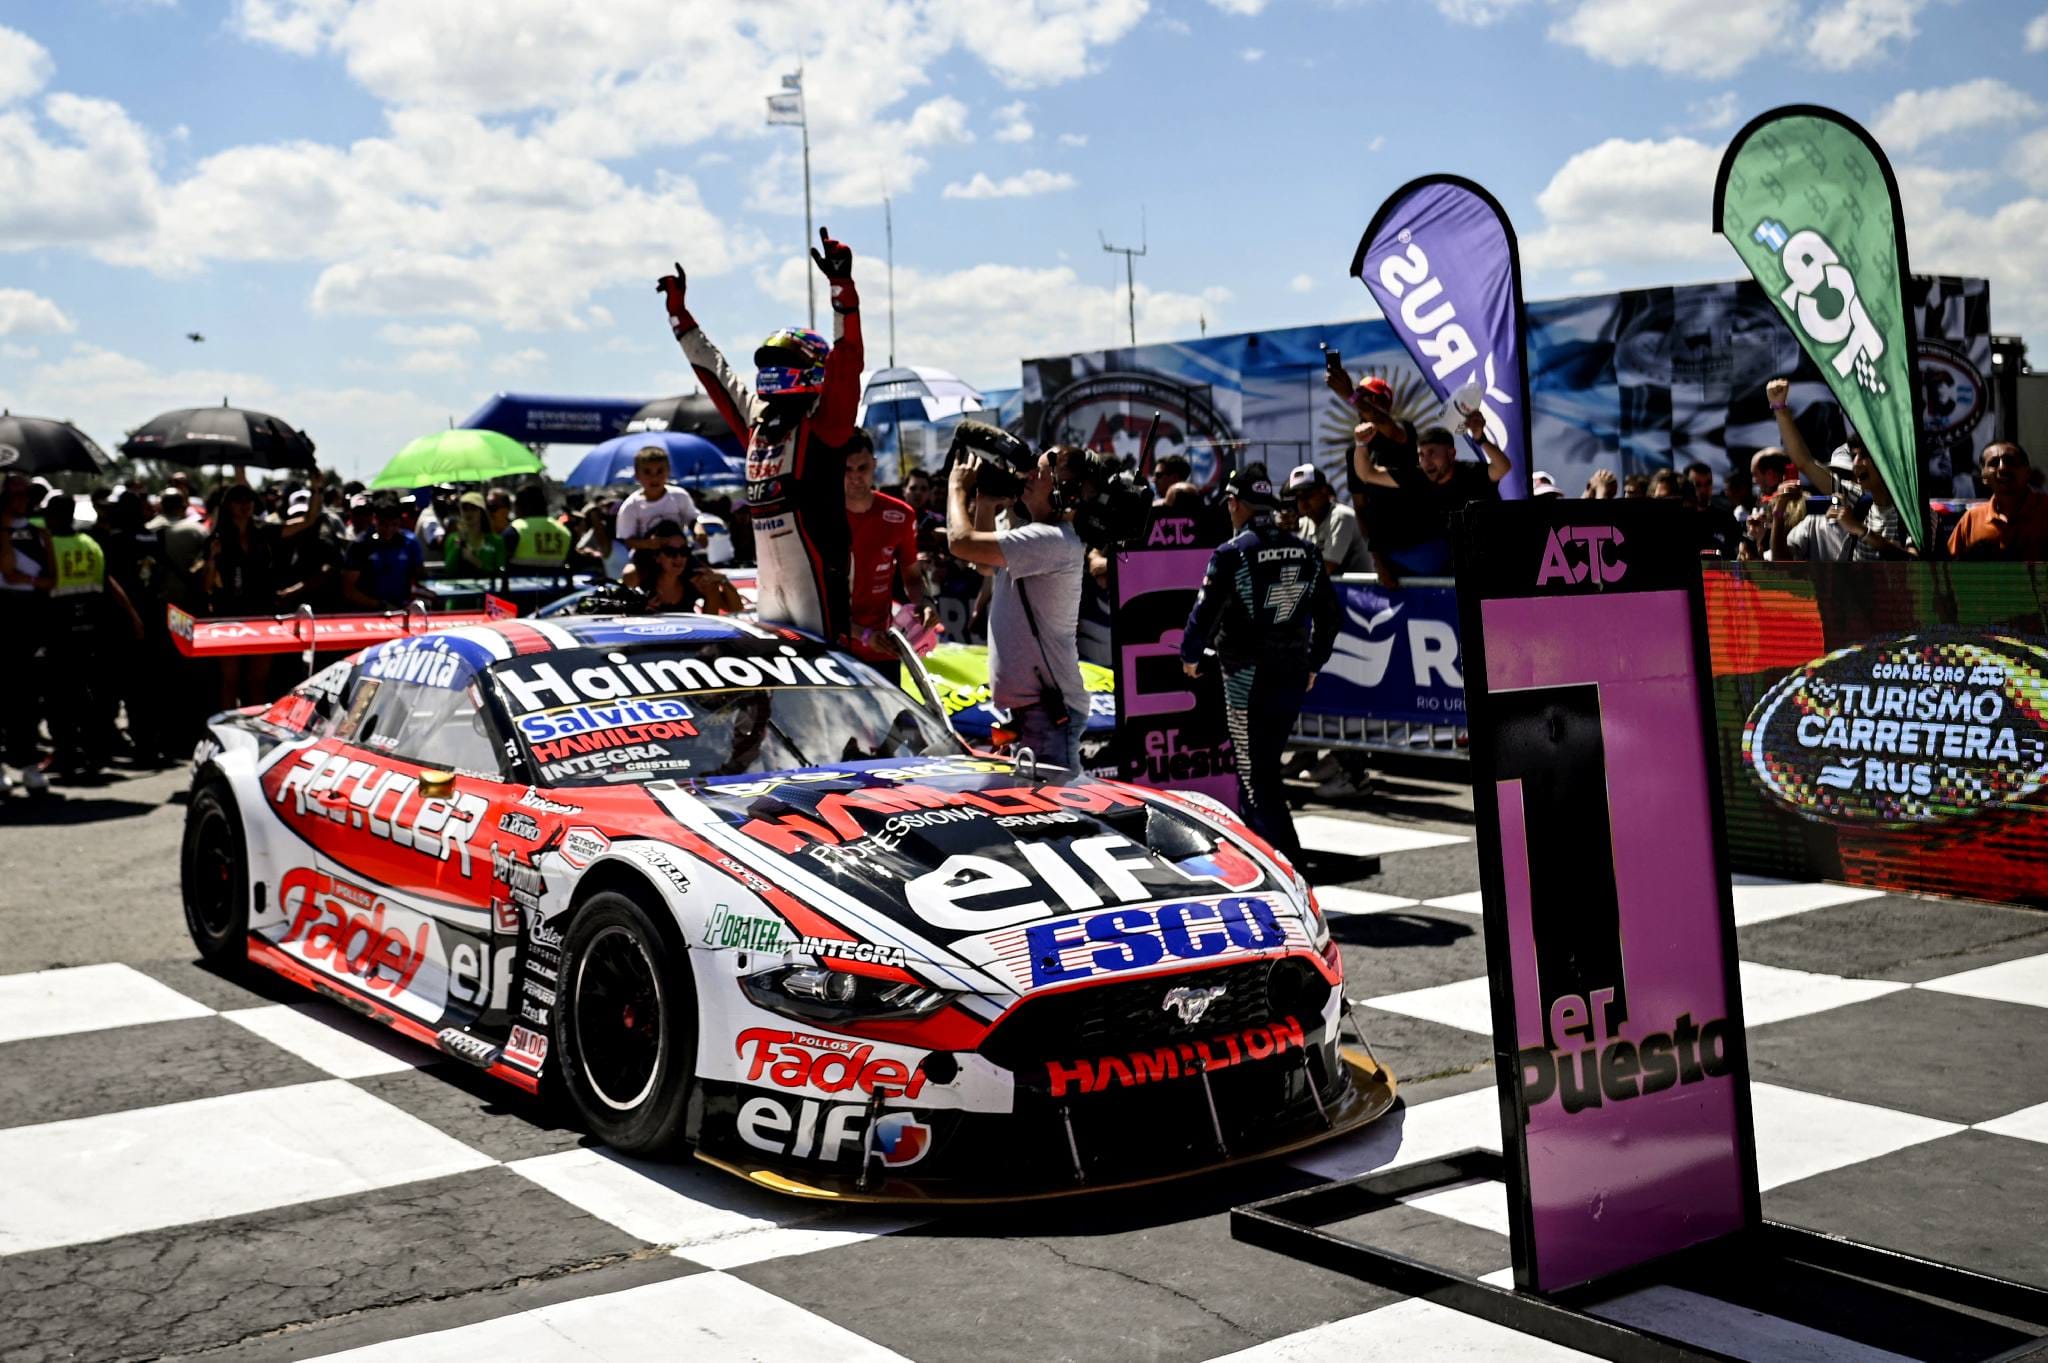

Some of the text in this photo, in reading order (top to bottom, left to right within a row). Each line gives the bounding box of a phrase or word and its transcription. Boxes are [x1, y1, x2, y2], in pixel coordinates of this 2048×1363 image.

[1147, 519, 1196, 546] ACTC
[1258, 547, 1307, 563] DOCTOR
[1536, 525, 1627, 586] ACTC
[369, 637, 460, 687] Salvita
[499, 644, 856, 712] Haimovic
[1872, 663, 1910, 681] COPA
[520, 699, 690, 742] Salvita
[1416, 696, 1465, 711] RIO UR
[1837, 684, 2003, 724] TURISMO
[504, 737, 519, 758] TC
[530, 720, 699, 763] HAMILTON
[1796, 715, 2019, 762] CARRETERA
[540, 743, 670, 782] INTEGRA
[625, 759, 691, 771] CRISTEM
[1864, 758, 1932, 796] RUS
[568, 834, 605, 852] DETROIT
[905, 834, 1153, 932] elf
[279, 866, 430, 998] Fadel
[704, 903, 782, 953] POBATER
[1025, 896, 1289, 987] ESCO
[799, 936, 906, 968] INTEGRA
[1550, 985, 1614, 1054] er
[798, 1035, 851, 1052] POLLOS
[1046, 1015, 1305, 1097] HAMILTON
[736, 1097, 867, 1162] elf
